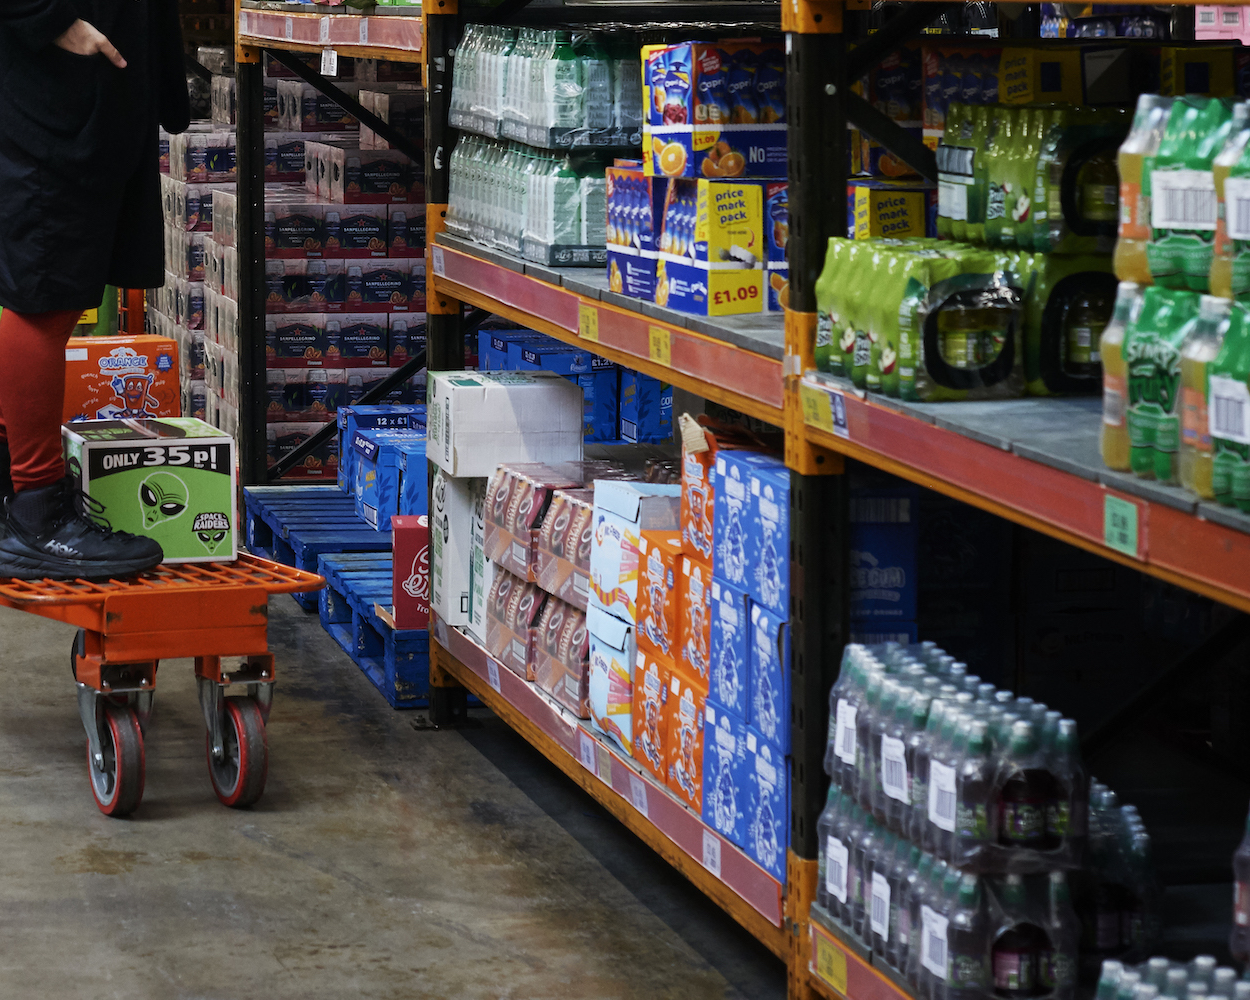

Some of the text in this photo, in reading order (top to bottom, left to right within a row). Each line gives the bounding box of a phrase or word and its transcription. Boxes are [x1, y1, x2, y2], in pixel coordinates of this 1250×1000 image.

[749, 146, 765, 163] NO
[715, 189, 743, 202] price
[718, 200, 746, 212] mark
[877, 199, 906, 211] price
[720, 211, 747, 225] pack
[879, 209, 908, 220] mark
[882, 221, 910, 234] pack
[714, 285, 758, 304] £1.09
[100, 357, 147, 367] ORANGE
[103, 446, 217, 469] ONLY 35p!
[194, 520, 229, 530] RAIDERS
